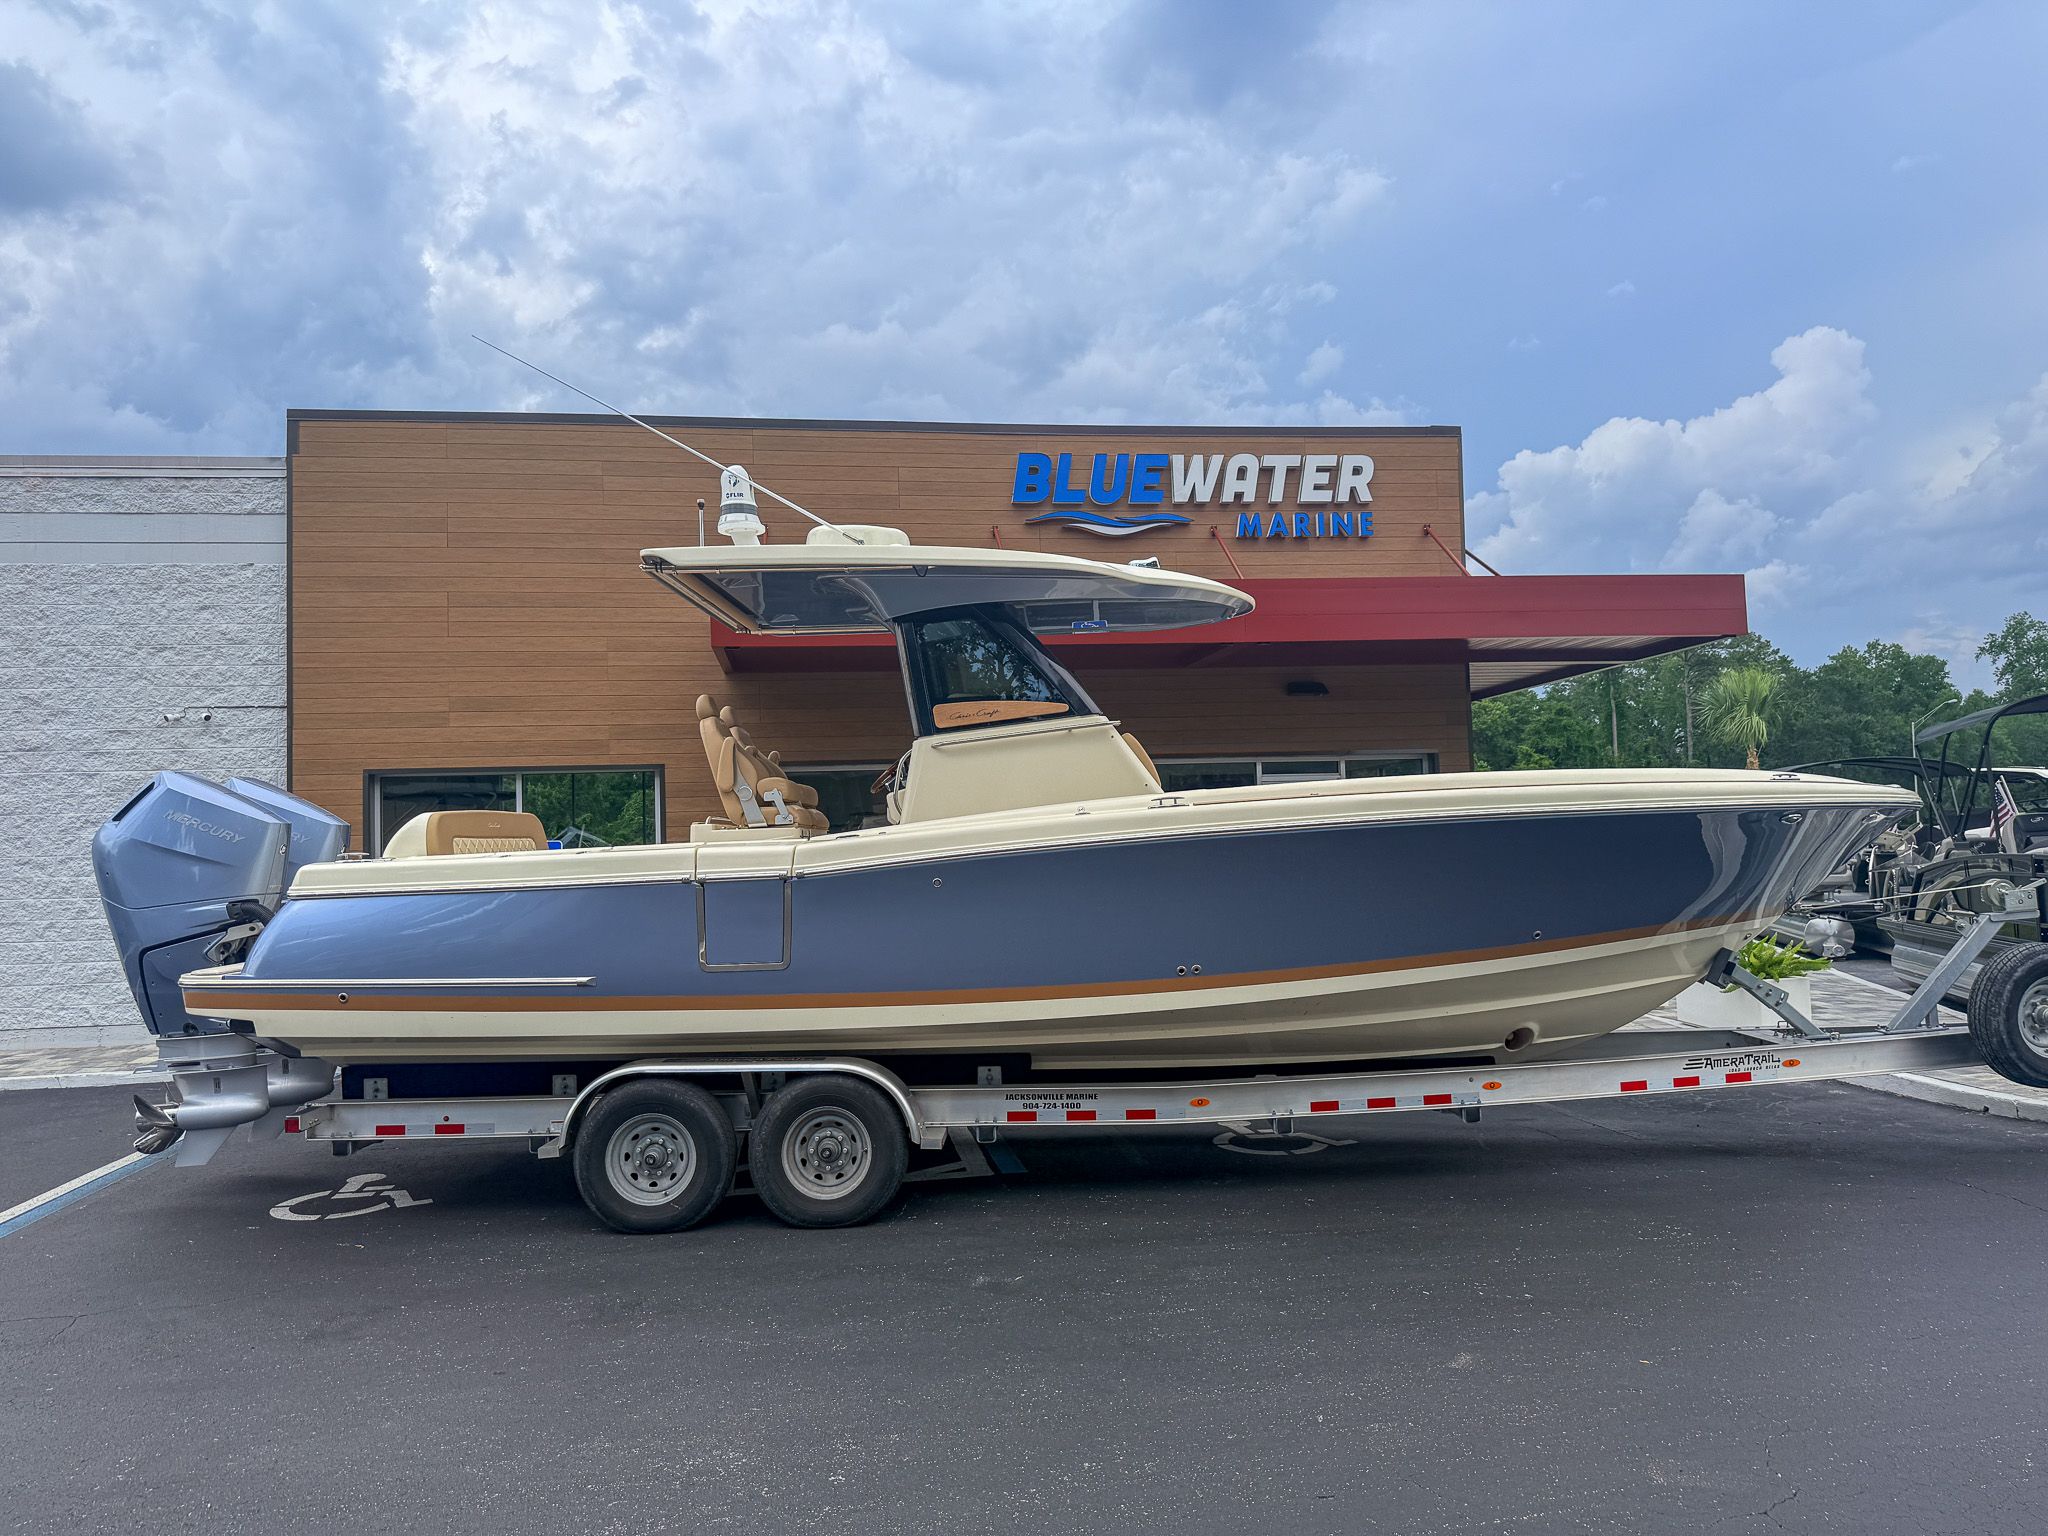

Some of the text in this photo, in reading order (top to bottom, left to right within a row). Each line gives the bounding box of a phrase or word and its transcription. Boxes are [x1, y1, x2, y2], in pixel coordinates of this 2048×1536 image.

[1012, 452, 1375, 505] BLUEWATER
[1236, 512, 1374, 538] MARINE
[163, 809, 246, 843] MERCURY
